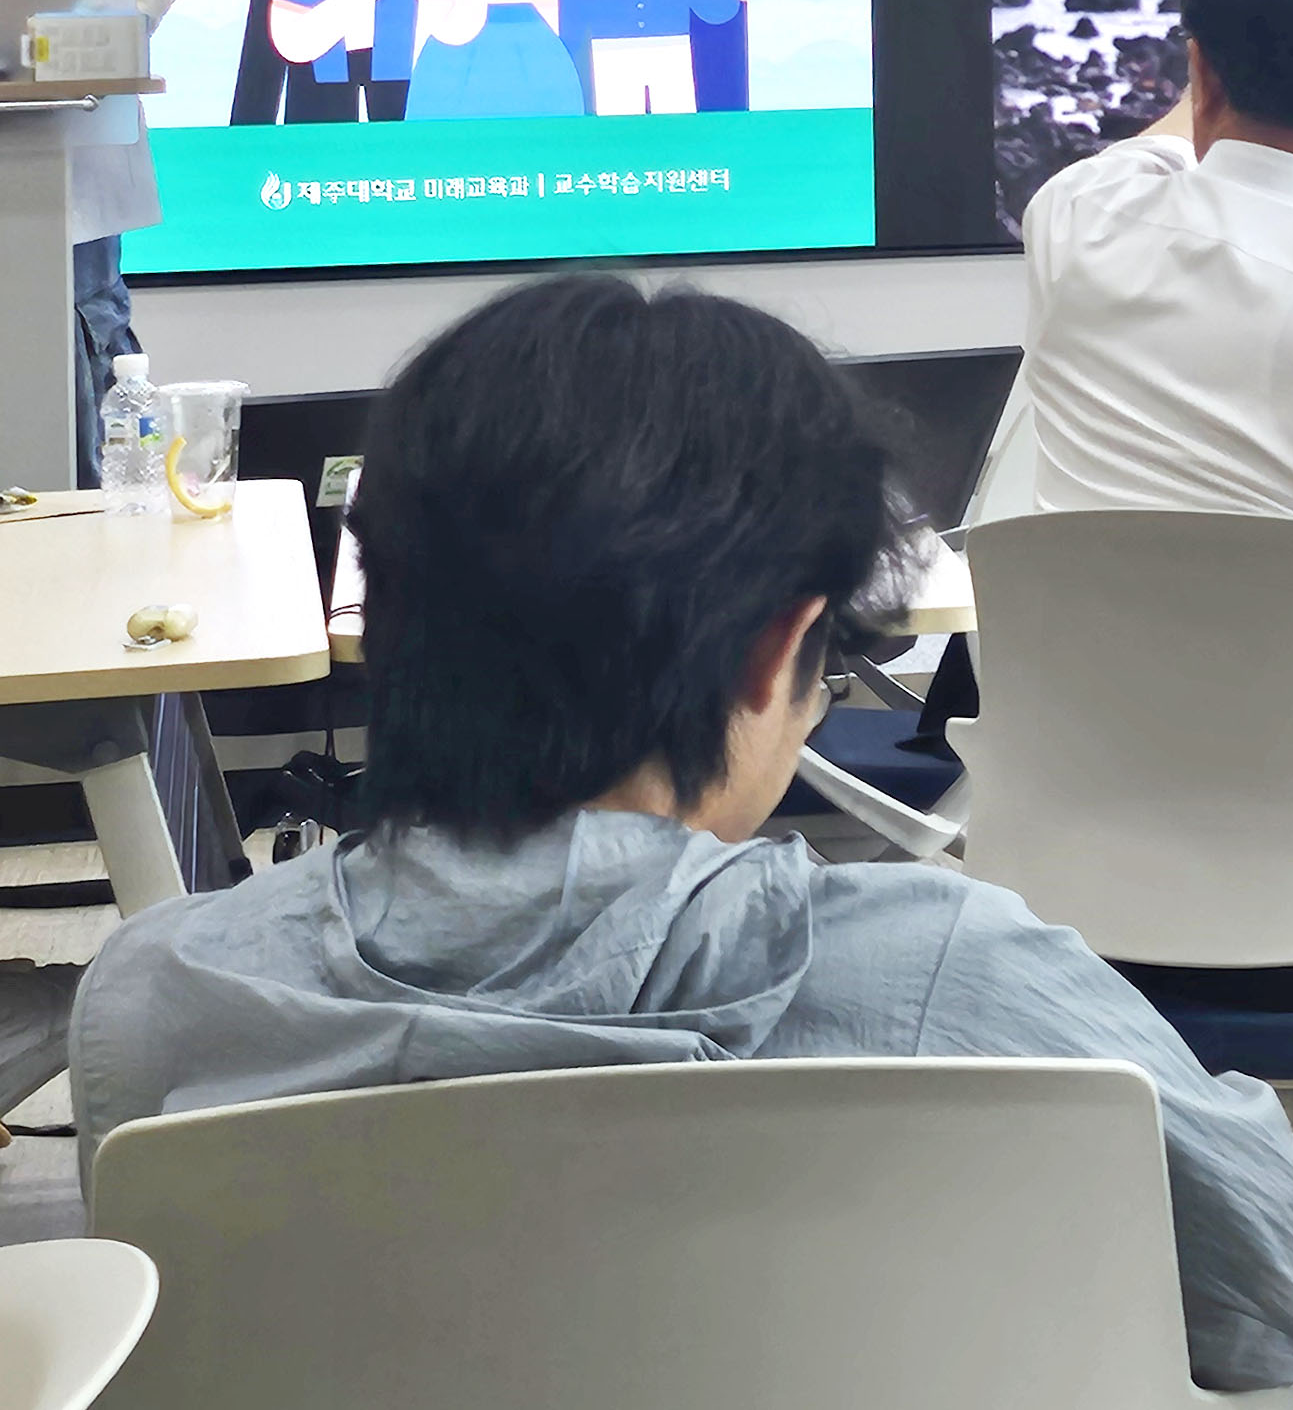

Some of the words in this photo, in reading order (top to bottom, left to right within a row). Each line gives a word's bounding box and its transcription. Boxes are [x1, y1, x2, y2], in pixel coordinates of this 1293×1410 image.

[295, 177, 418, 207] 제주대학교
[421, 173, 532, 202] 미래교육과
[551, 166, 732, 198] 교수학습지원센터
